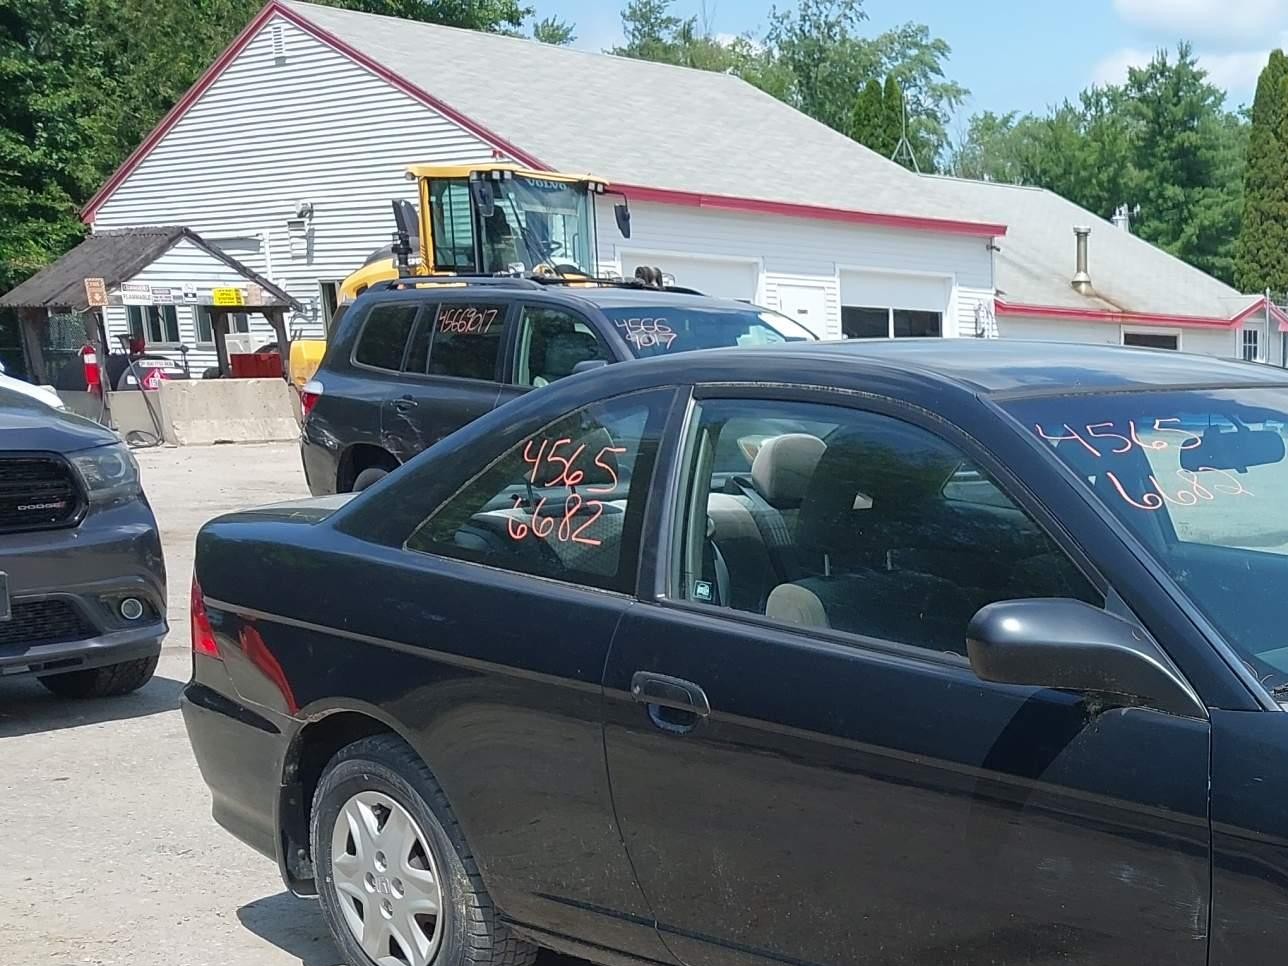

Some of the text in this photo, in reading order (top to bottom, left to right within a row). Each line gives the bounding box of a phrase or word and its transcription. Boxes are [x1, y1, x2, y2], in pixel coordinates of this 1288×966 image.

[526, 179, 567, 190] VOLVO
[614, 318, 672, 335] 4566
[1035, 418, 1201, 457] 4565
[523, 439, 627, 492] 4565
[1106, 466, 1255, 510] 6682
[508, 493, 601, 545] 6682
